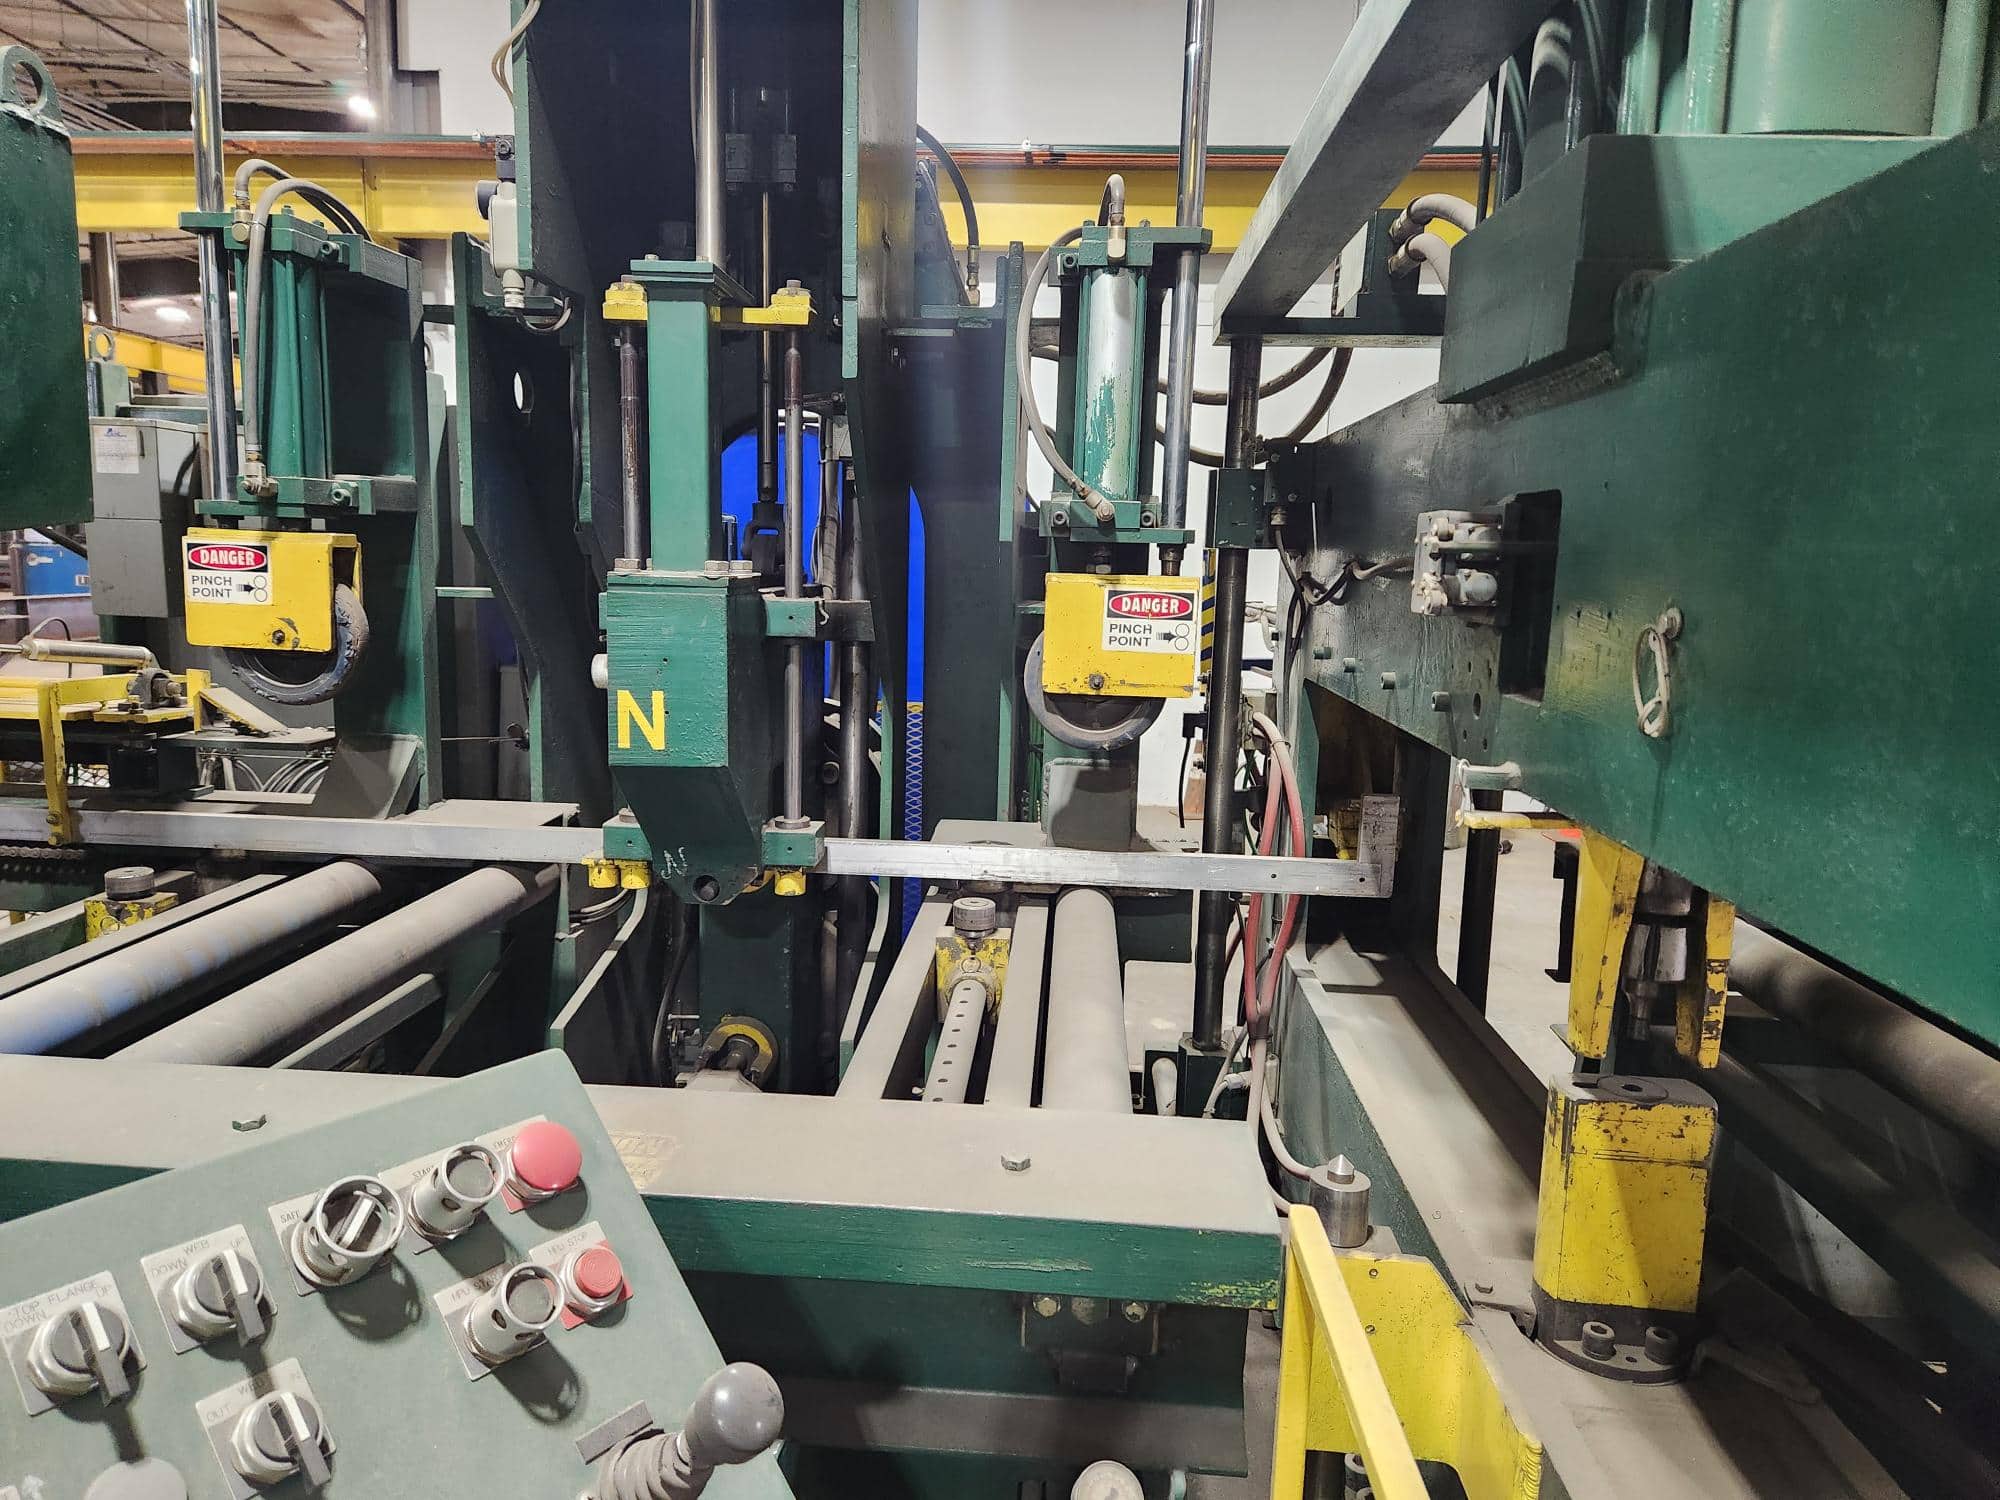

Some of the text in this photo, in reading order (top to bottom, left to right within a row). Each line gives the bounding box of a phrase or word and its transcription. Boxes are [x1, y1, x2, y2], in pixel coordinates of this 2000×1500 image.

[200, 549, 255, 566] DANGER
[192, 575, 232, 586] PINCH
[193, 587, 232, 598] POINT
[1121, 597, 1179, 614] DANGER
[1110, 623, 1152, 634] PINCH
[1109, 636, 1151, 647] POINT
[617, 690, 665, 750] N
